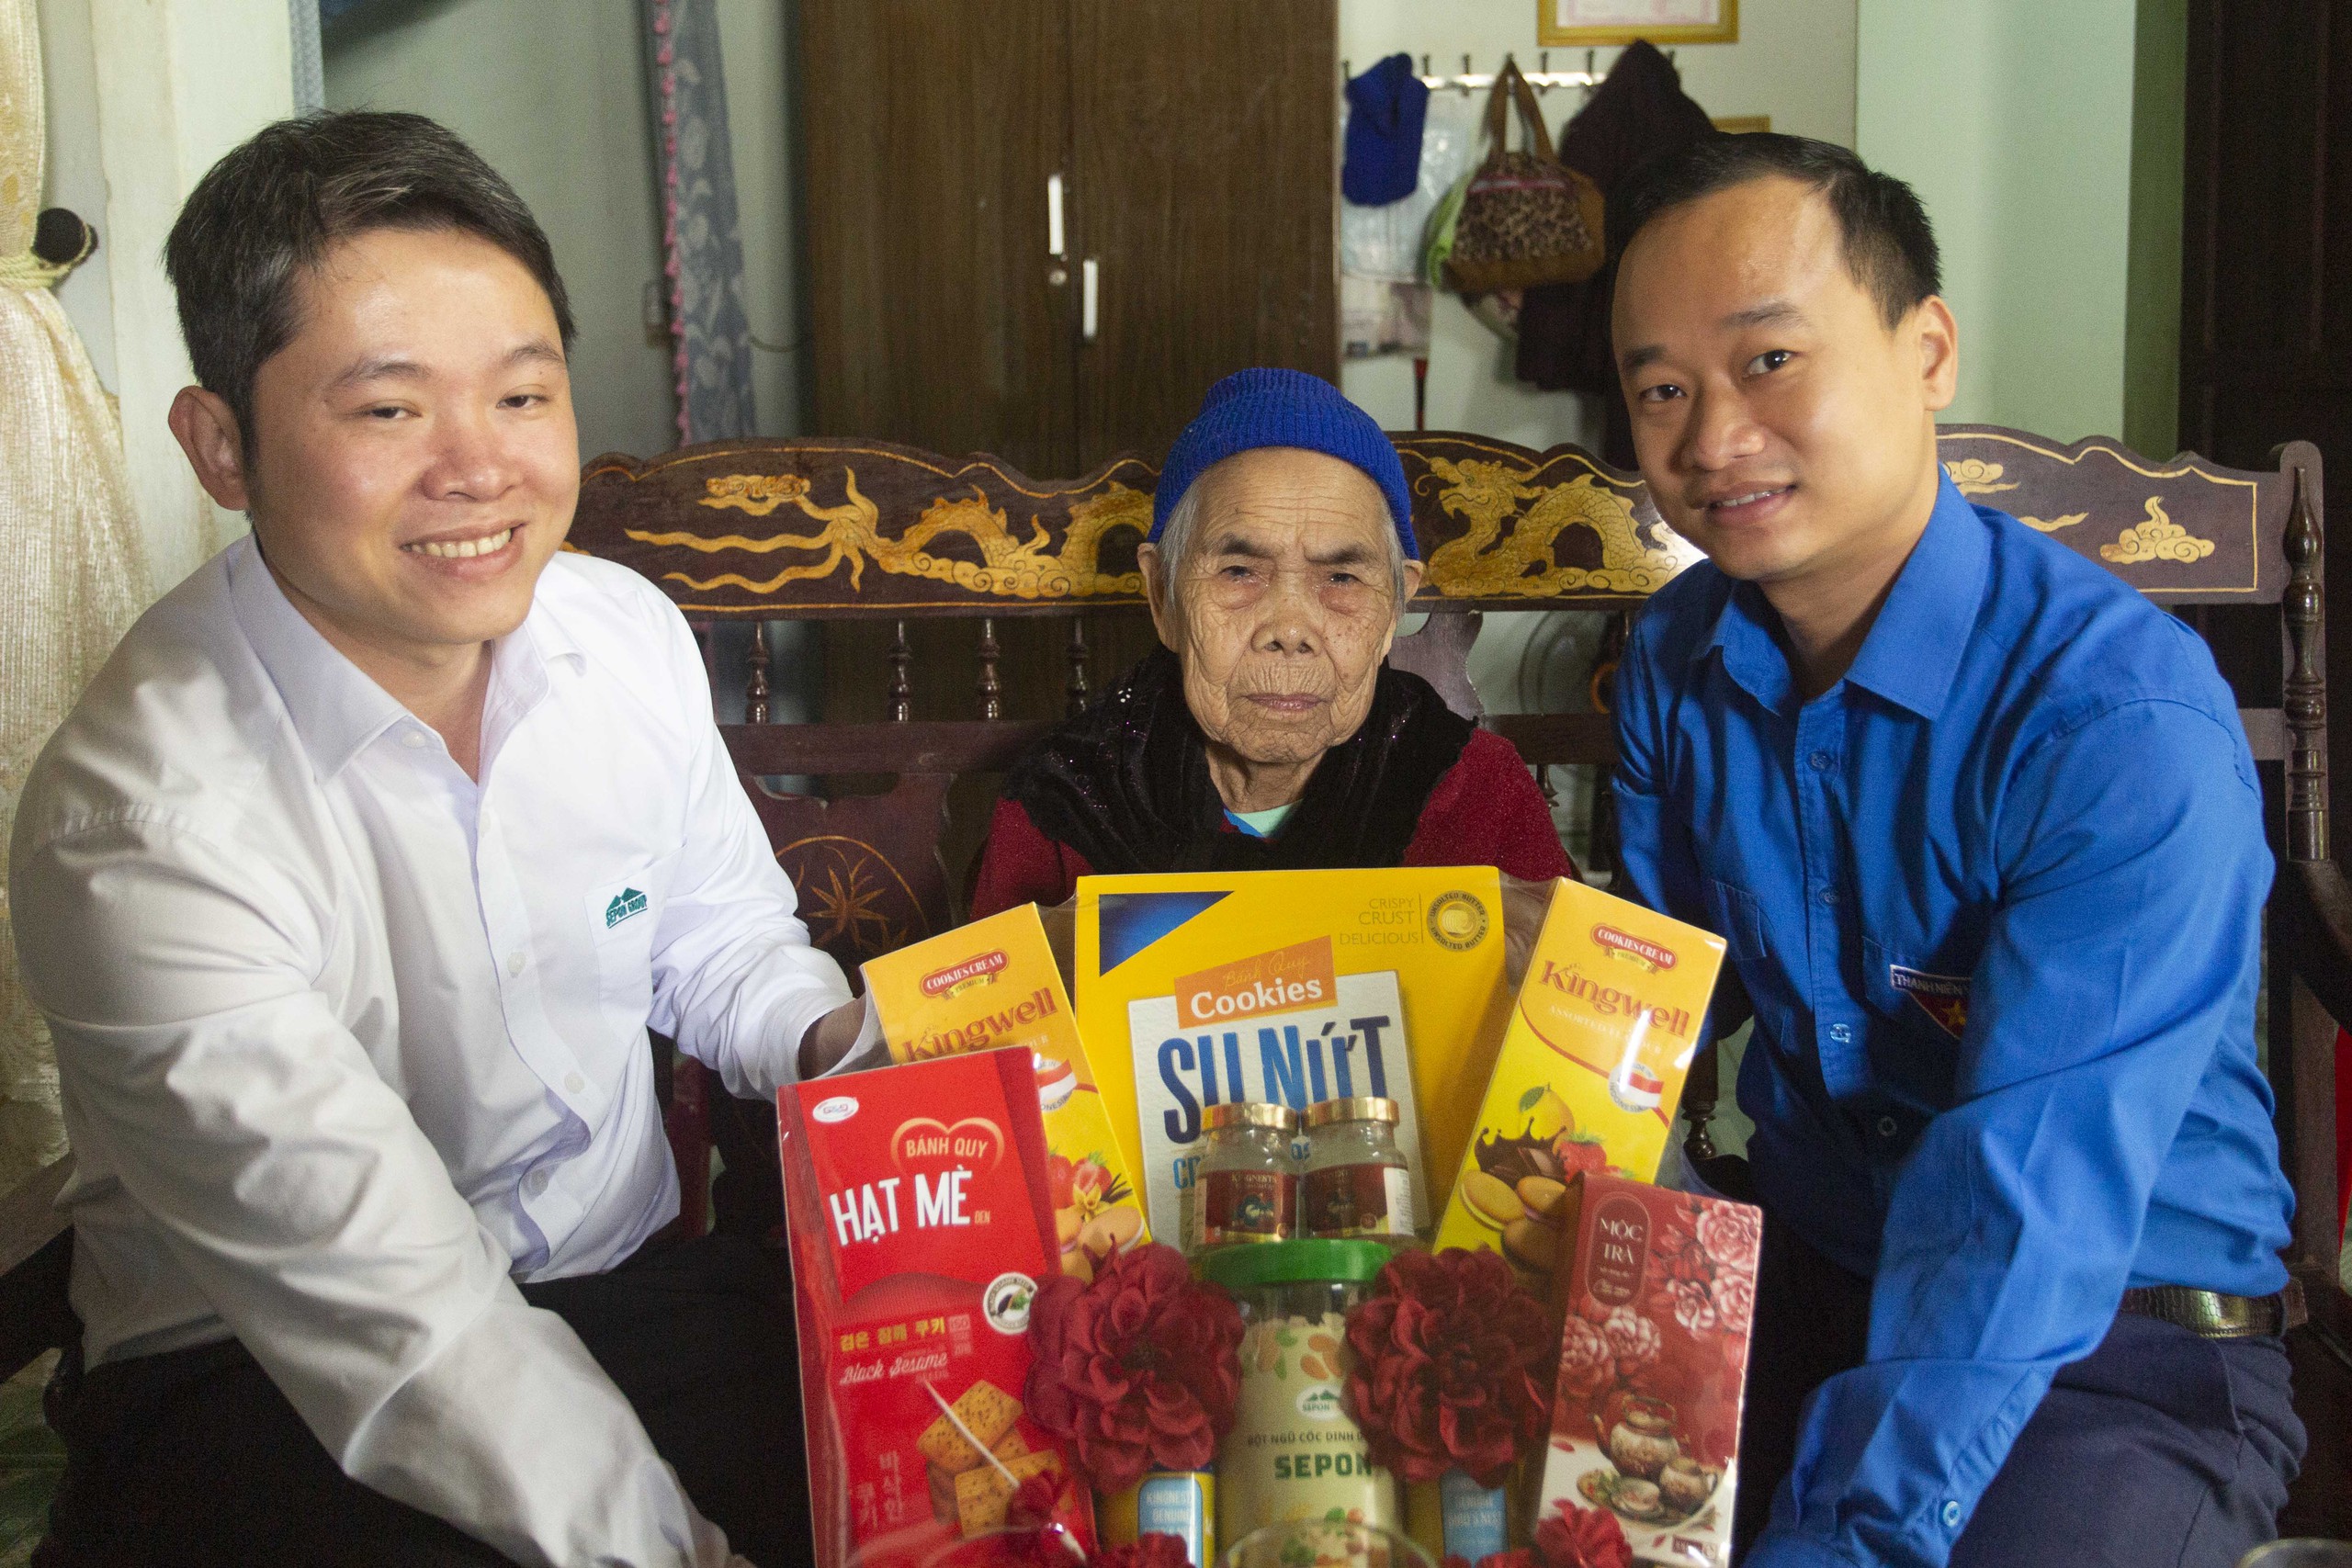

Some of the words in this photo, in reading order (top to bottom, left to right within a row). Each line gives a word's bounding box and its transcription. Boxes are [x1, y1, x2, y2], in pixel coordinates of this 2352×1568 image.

[606, 904, 628, 927] SEPON
[628, 894, 648, 912] GROUP
[1358, 911, 1415, 925] CRUST
[1369, 897, 1415, 909] CRISPY
[1340, 931, 1419, 945] DELICIOUS
[1598, 929, 1640, 953] COOKIES
[1639, 942, 1673, 964] CREAM
[926, 967, 969, 989] COOKIES
[968, 953, 1003, 976] CREAM
[1191, 977, 1323, 1020] Cookies
[1540, 960, 1690, 1037] Kingwell
[902, 987, 1058, 1062] Kingwell
[906, 1134, 949, 1158] BÁNH
[955, 1138, 989, 1158] QUY
[830, 1178, 900, 1247] HẠT
[914, 1164, 973, 1228] MÈ
[839, 1359, 884, 1386] Black
[1302, 1403, 1330, 1413] SEPON
[1274, 1451, 1373, 1480] SEPON
